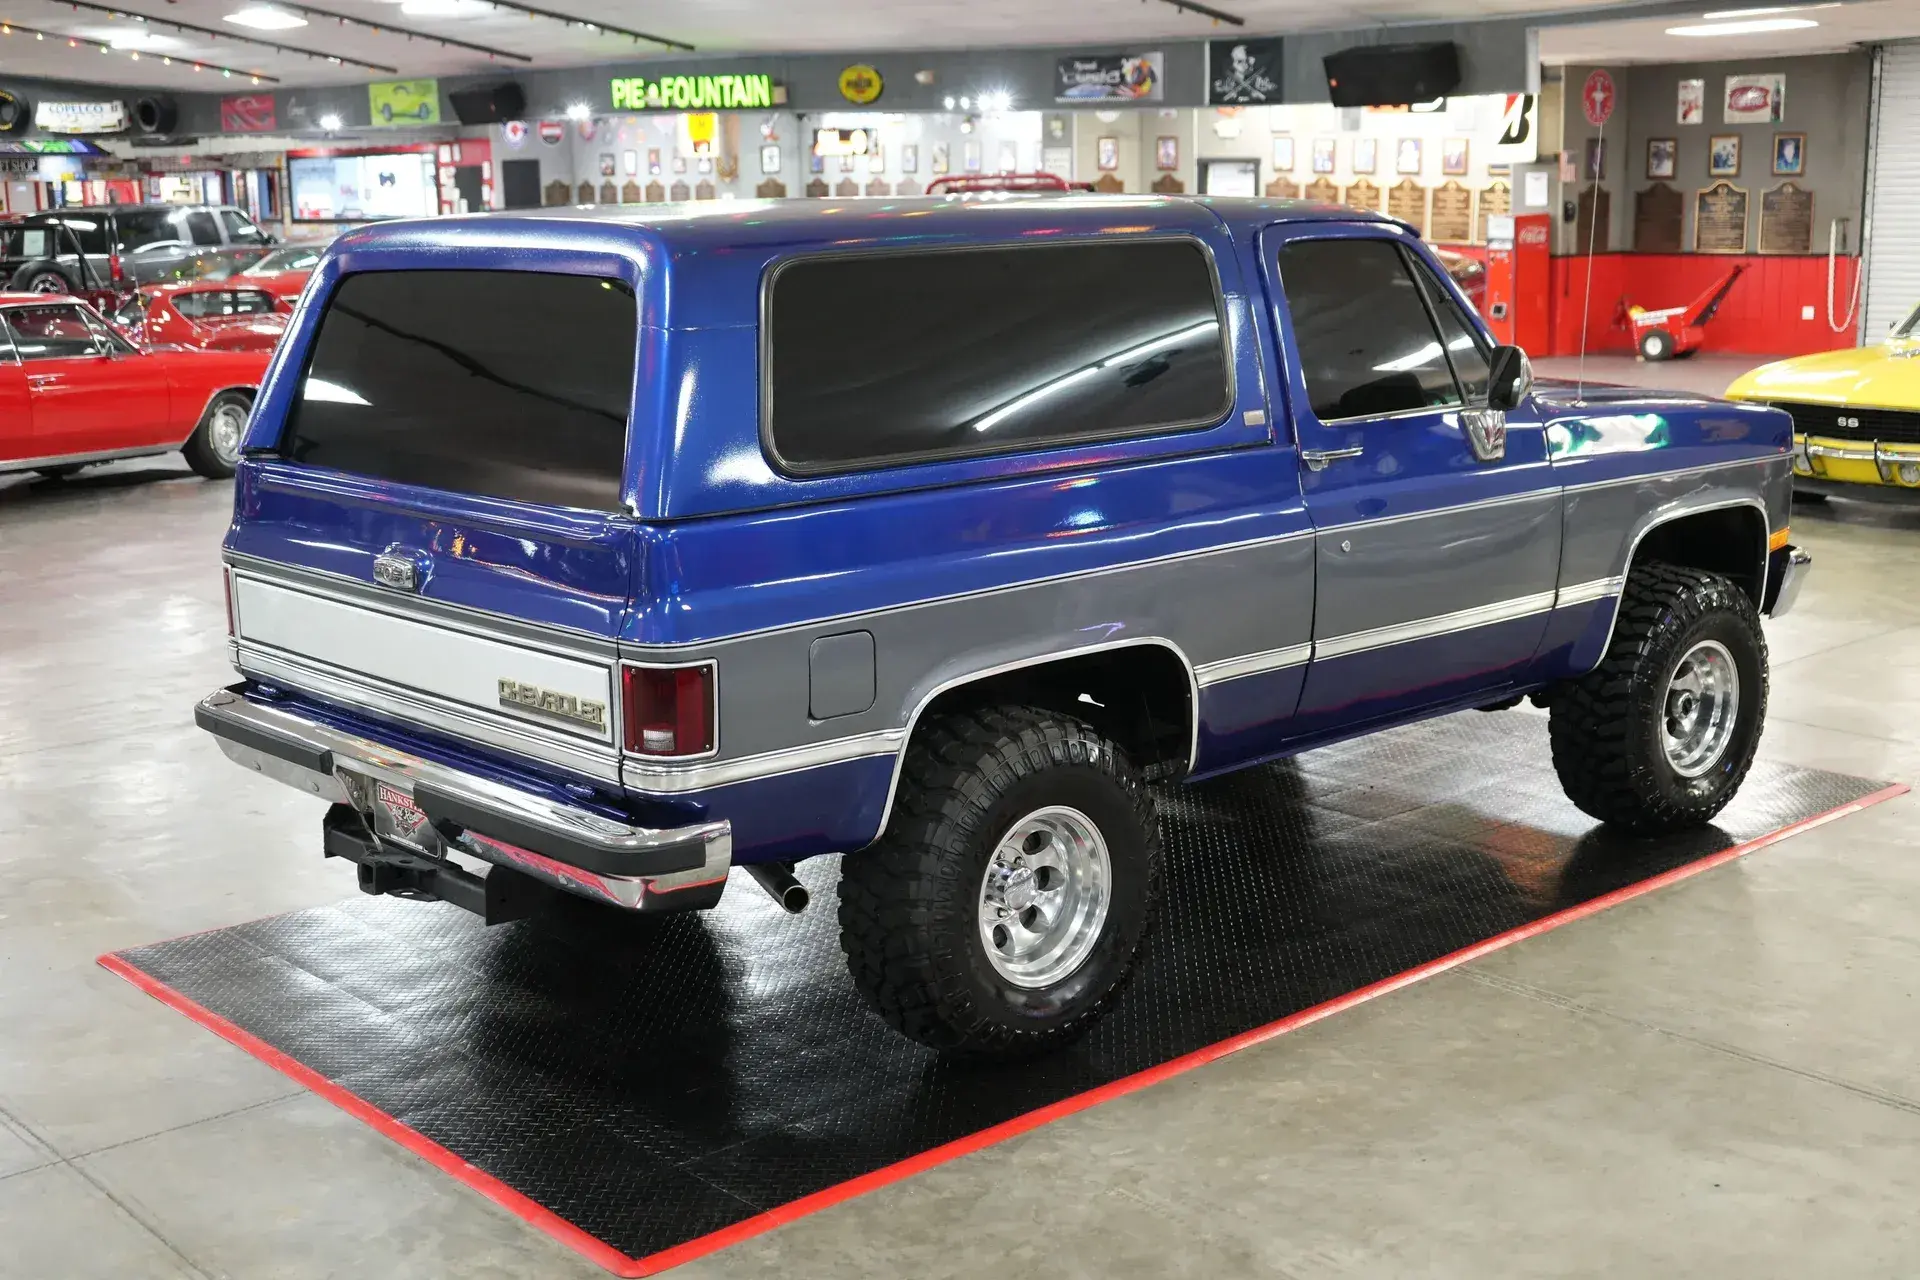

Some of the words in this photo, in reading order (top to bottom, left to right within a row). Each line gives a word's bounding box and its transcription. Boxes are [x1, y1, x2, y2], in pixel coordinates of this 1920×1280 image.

[611, 78, 646, 109] PIE
[660, 74, 770, 108] FOUNTAIN
[1837, 416, 1859, 428] SS
[498, 677, 605, 728] CHEVROLET
